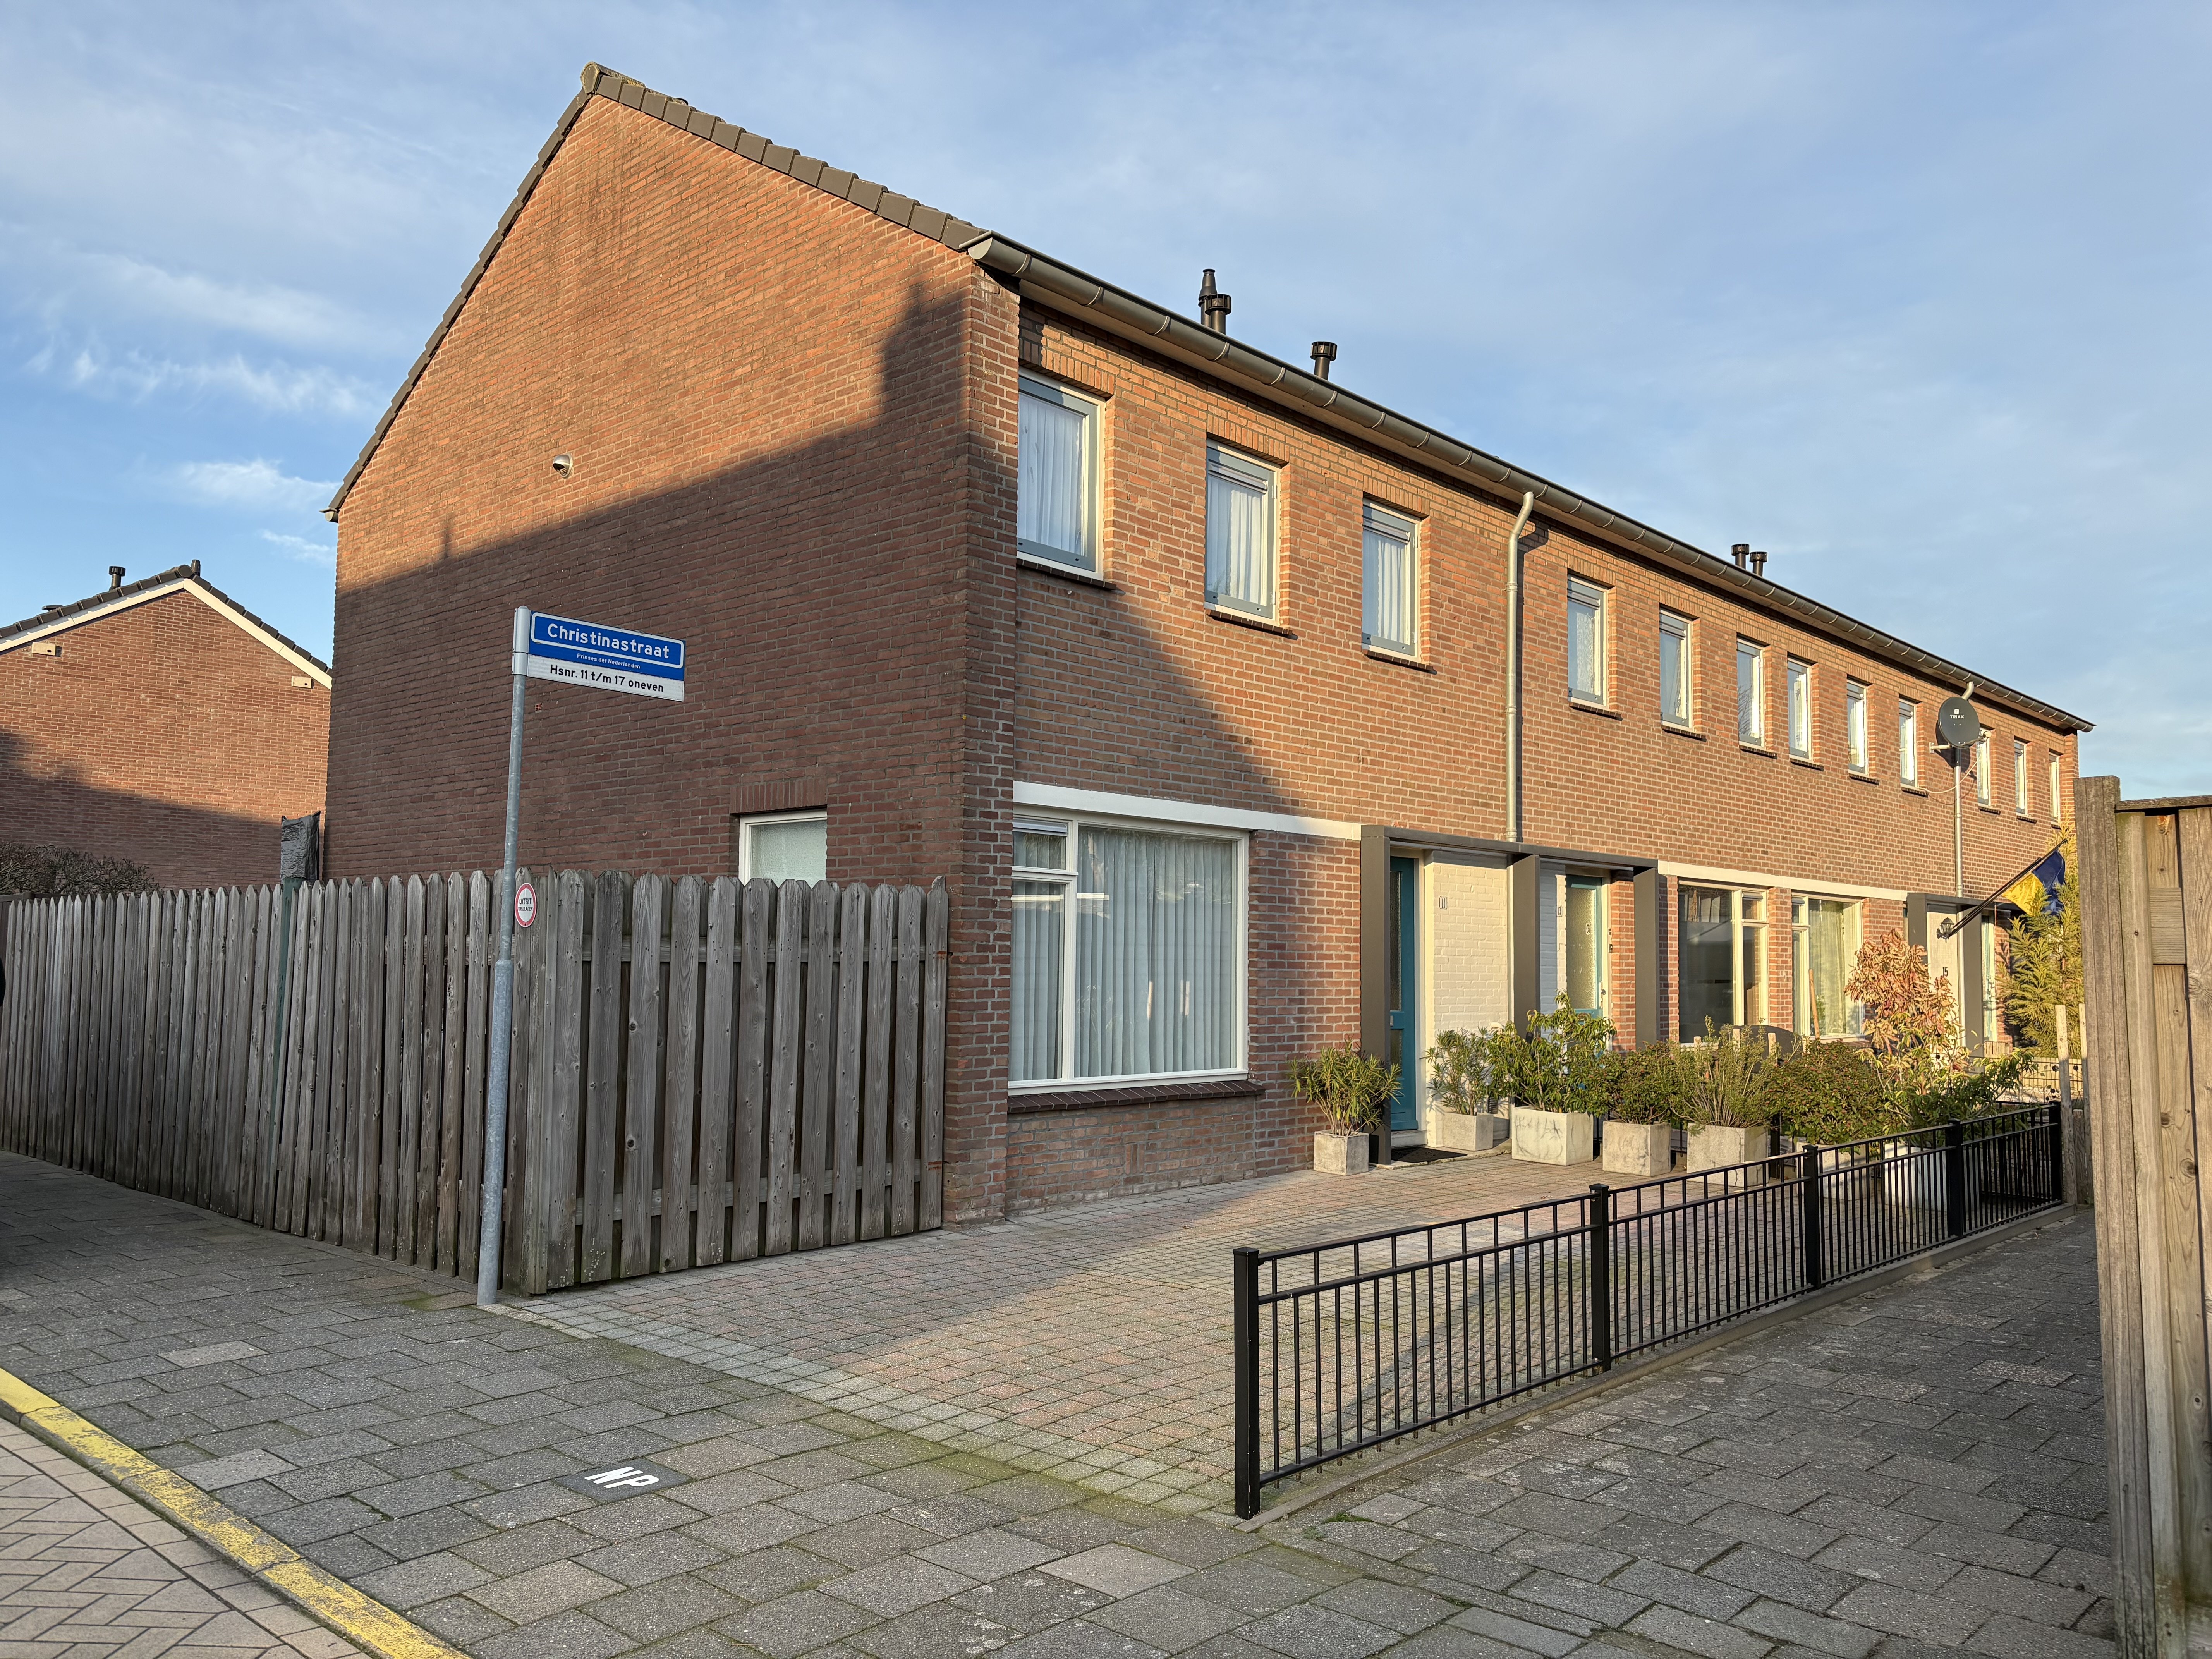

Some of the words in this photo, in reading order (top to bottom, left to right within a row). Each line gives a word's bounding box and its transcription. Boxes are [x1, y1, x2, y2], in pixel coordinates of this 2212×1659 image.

[548, 623, 669, 659] Christinastraat
[577, 653, 597, 661] Prinses
[608, 659, 640, 669] Nederlanden
[550, 664, 577, 678] Hsnr.
[581, 670, 587, 679] 11
[591, 673, 611, 684] t/m
[615, 676, 625, 685] 17
[628, 680, 664, 692] oneven
[1441, 897, 1446, 908] 11
[1942, 967, 1948, 977] 15
[584, 1466, 659, 1489] NP
